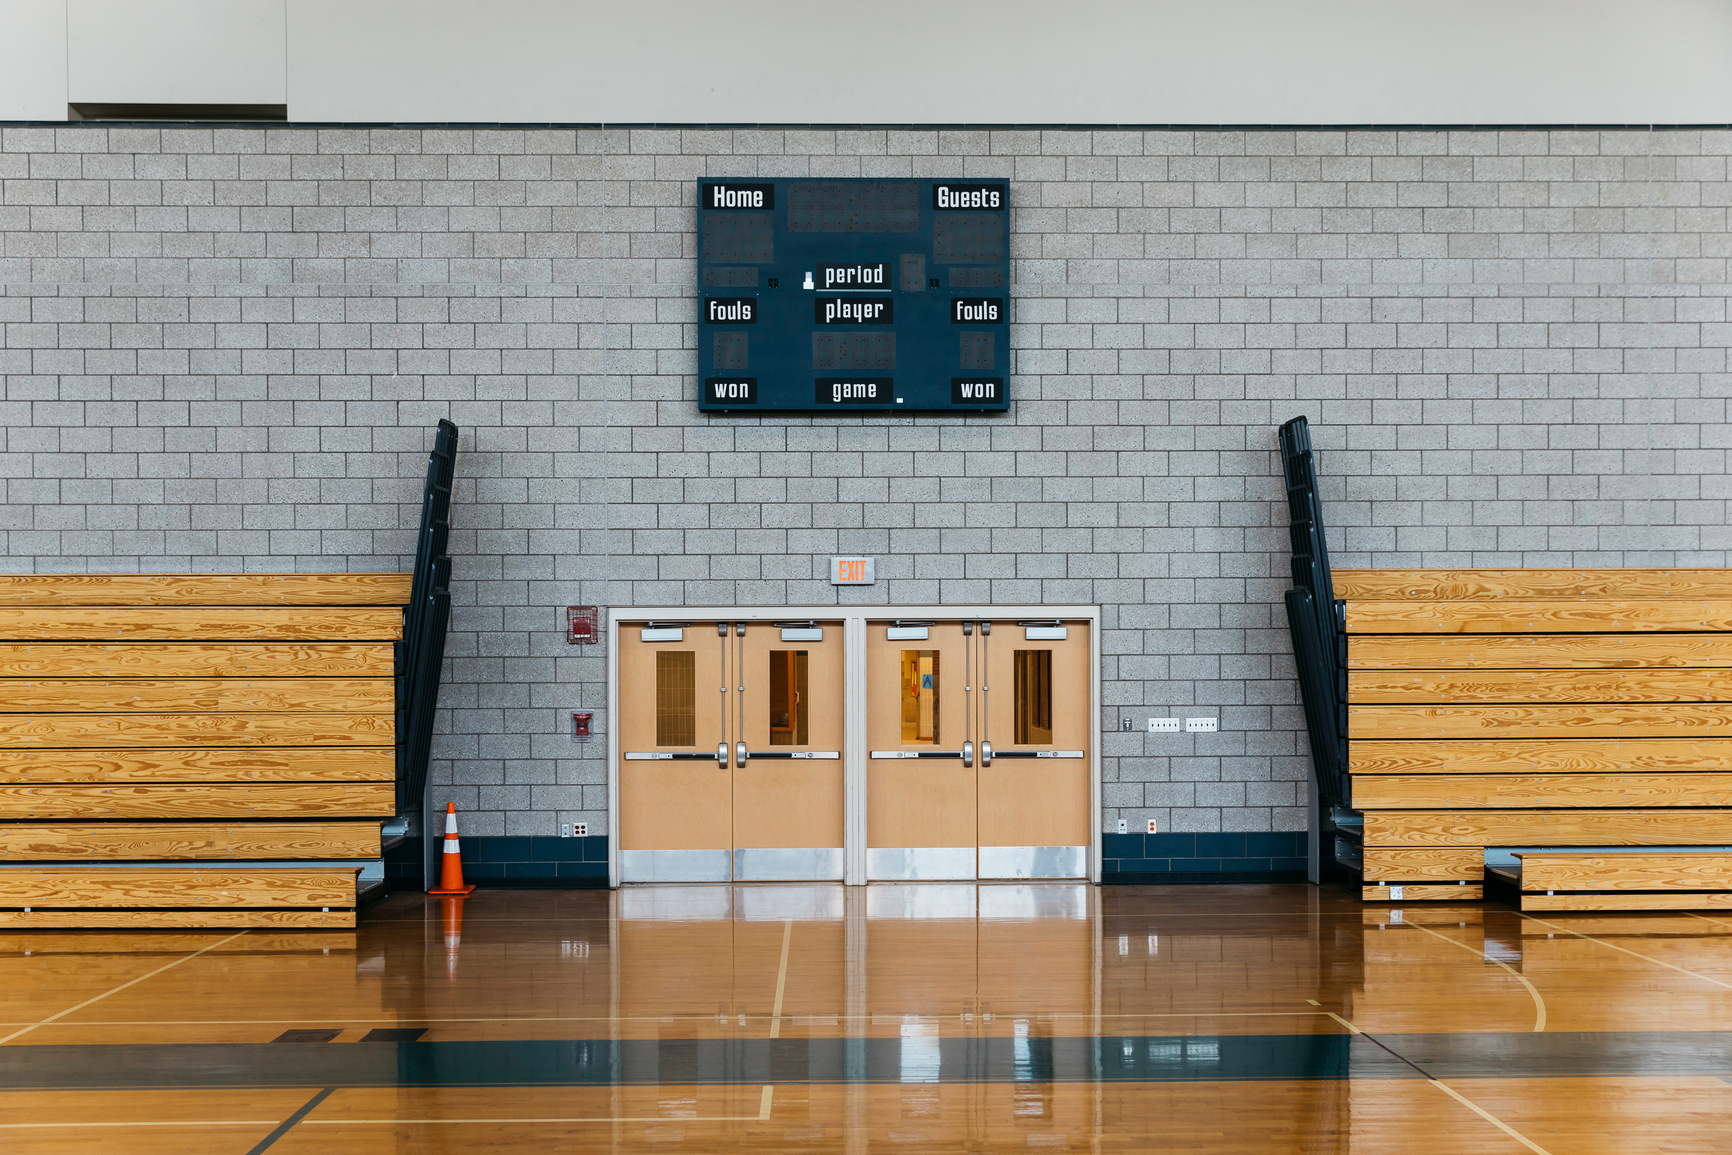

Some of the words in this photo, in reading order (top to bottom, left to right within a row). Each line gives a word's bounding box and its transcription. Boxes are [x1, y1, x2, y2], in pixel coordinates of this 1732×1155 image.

[714, 186, 763, 207] Home
[938, 187, 1000, 208] Guests
[825, 264, 883, 287] period
[710, 301, 751, 320] fouls
[825, 300, 884, 323] player
[957, 301, 998, 320] fouls
[714, 383, 749, 398] won
[832, 383, 877, 402] game
[960, 383, 995, 398] won
[839, 561, 866, 581] EXIT
